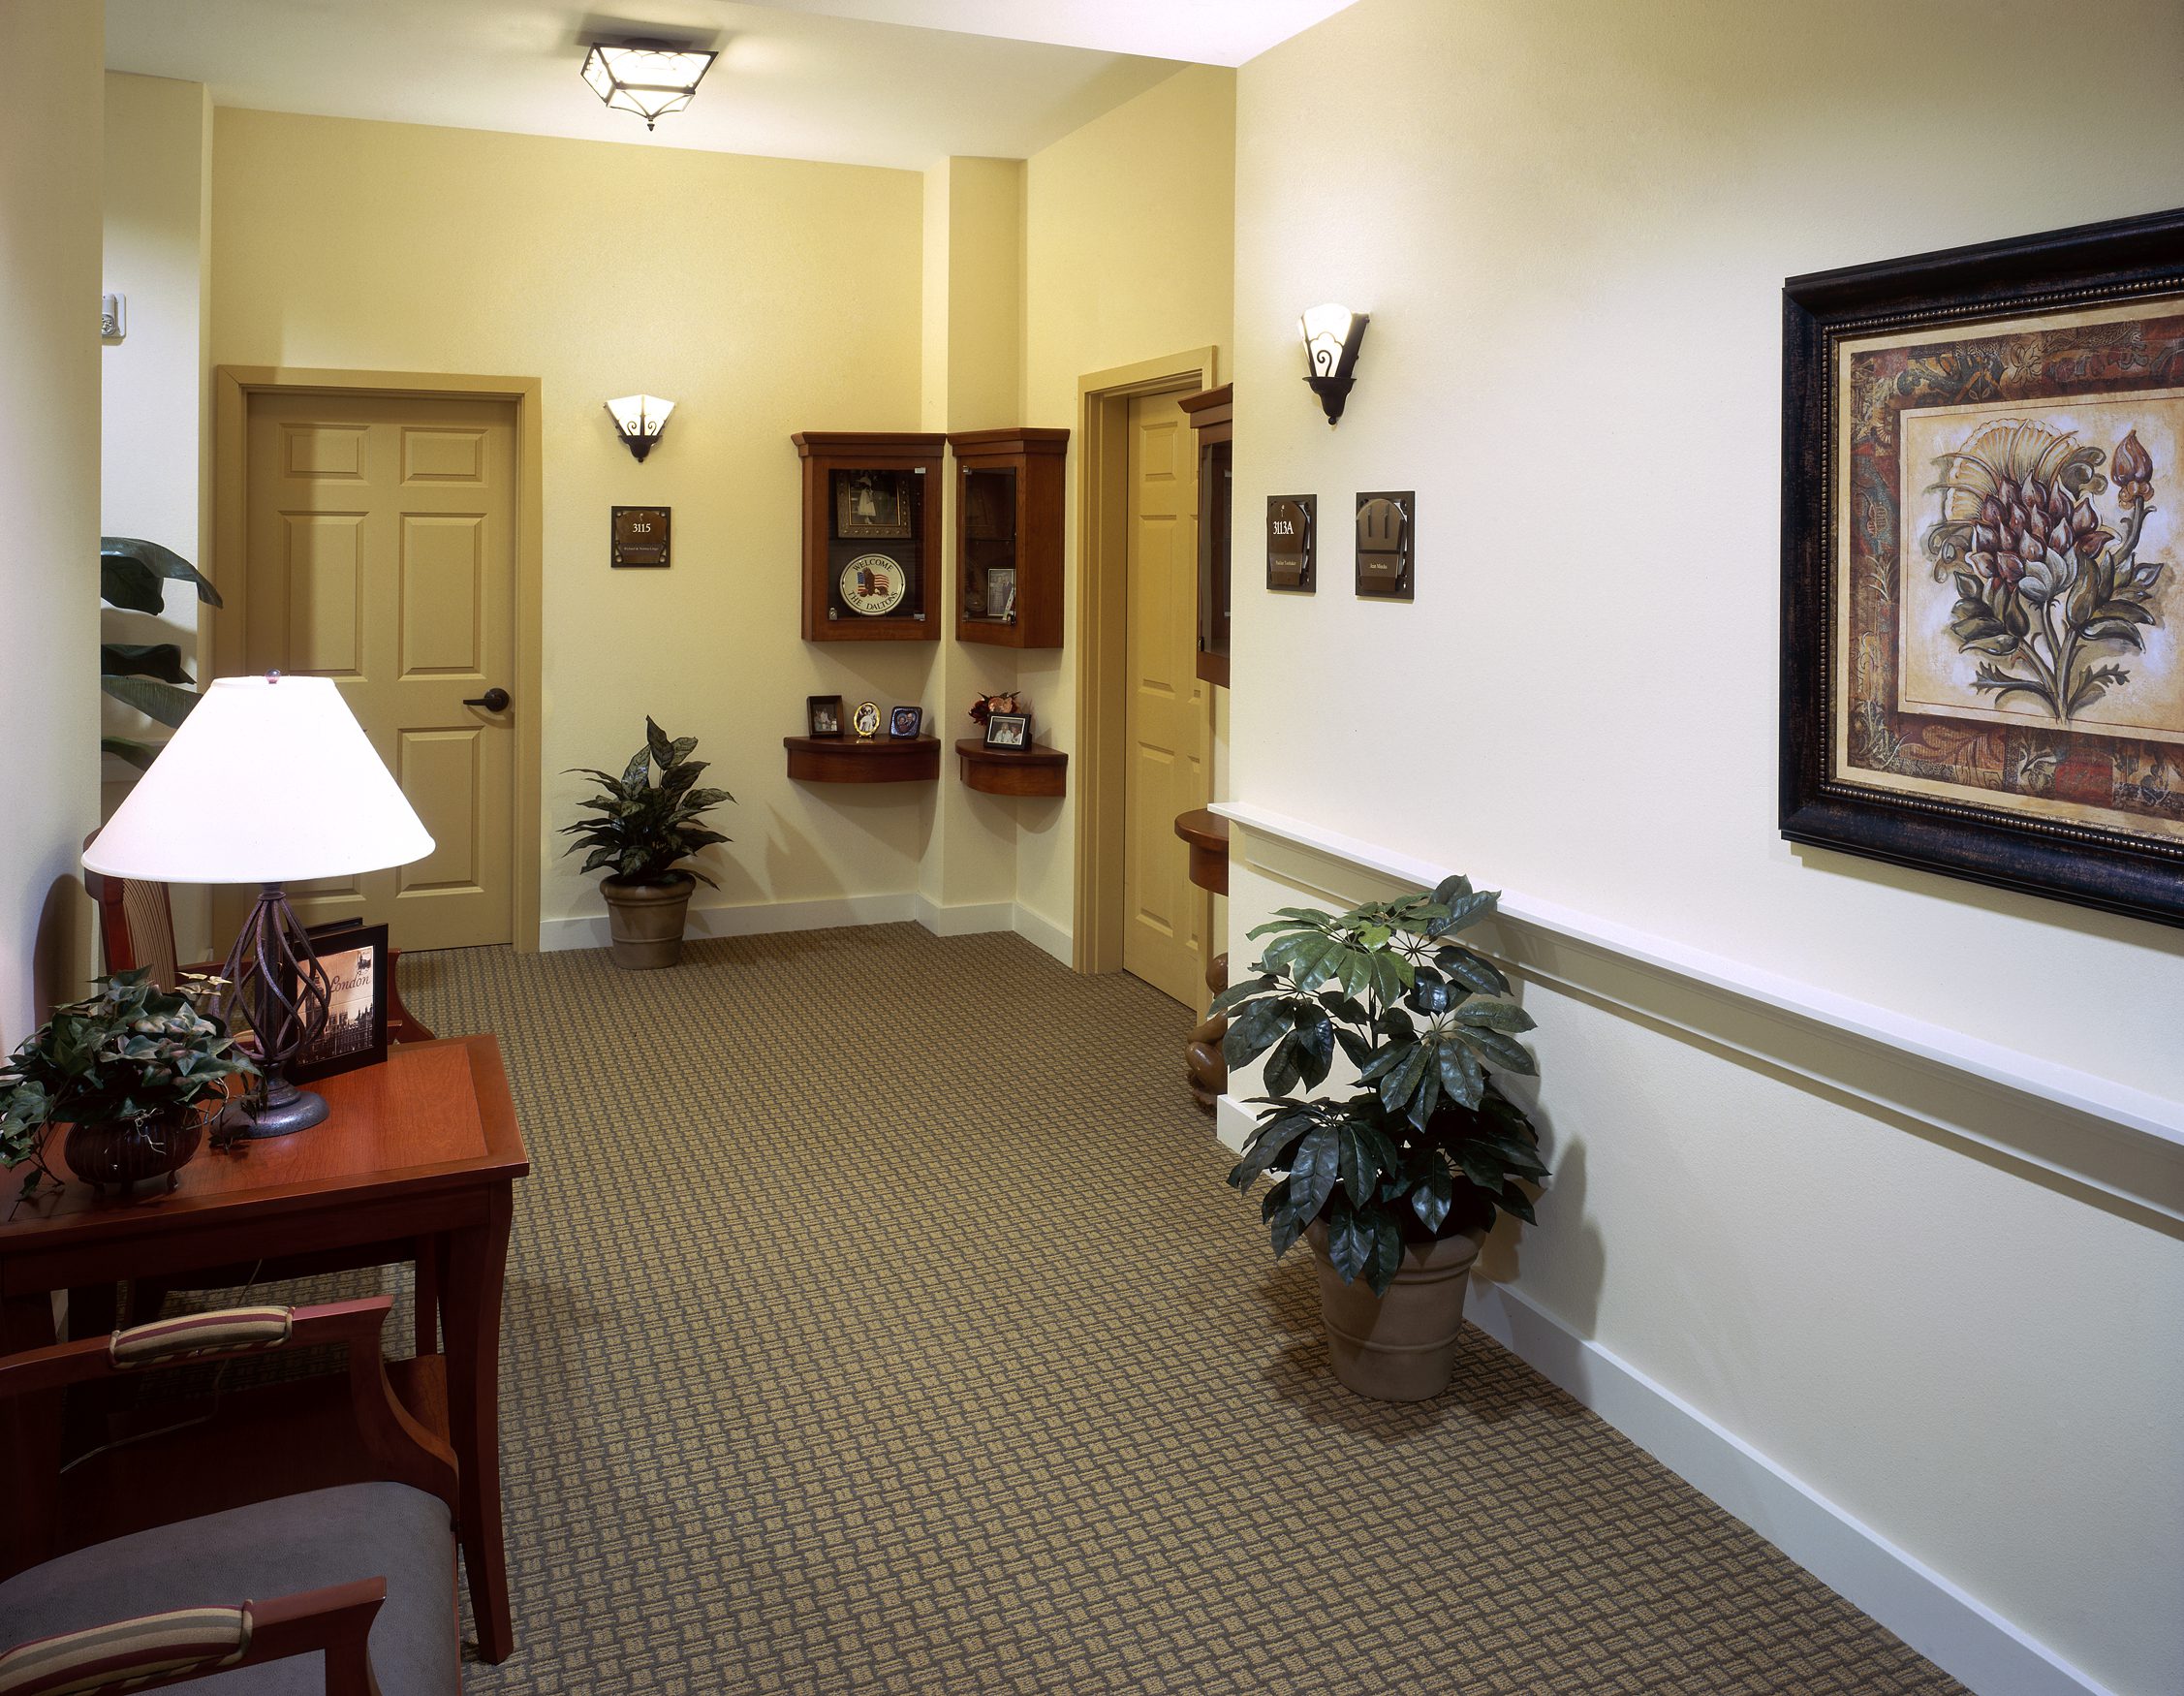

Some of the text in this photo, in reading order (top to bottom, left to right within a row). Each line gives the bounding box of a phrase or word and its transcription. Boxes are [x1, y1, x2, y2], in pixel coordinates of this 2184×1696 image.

[633, 523, 651, 533] 3115
[1272, 520, 1294, 535] 3113A
[853, 558, 893, 573] WELCOME
[848, 590, 898, 611] THE DALTONS
[330, 971, 370, 993] London
